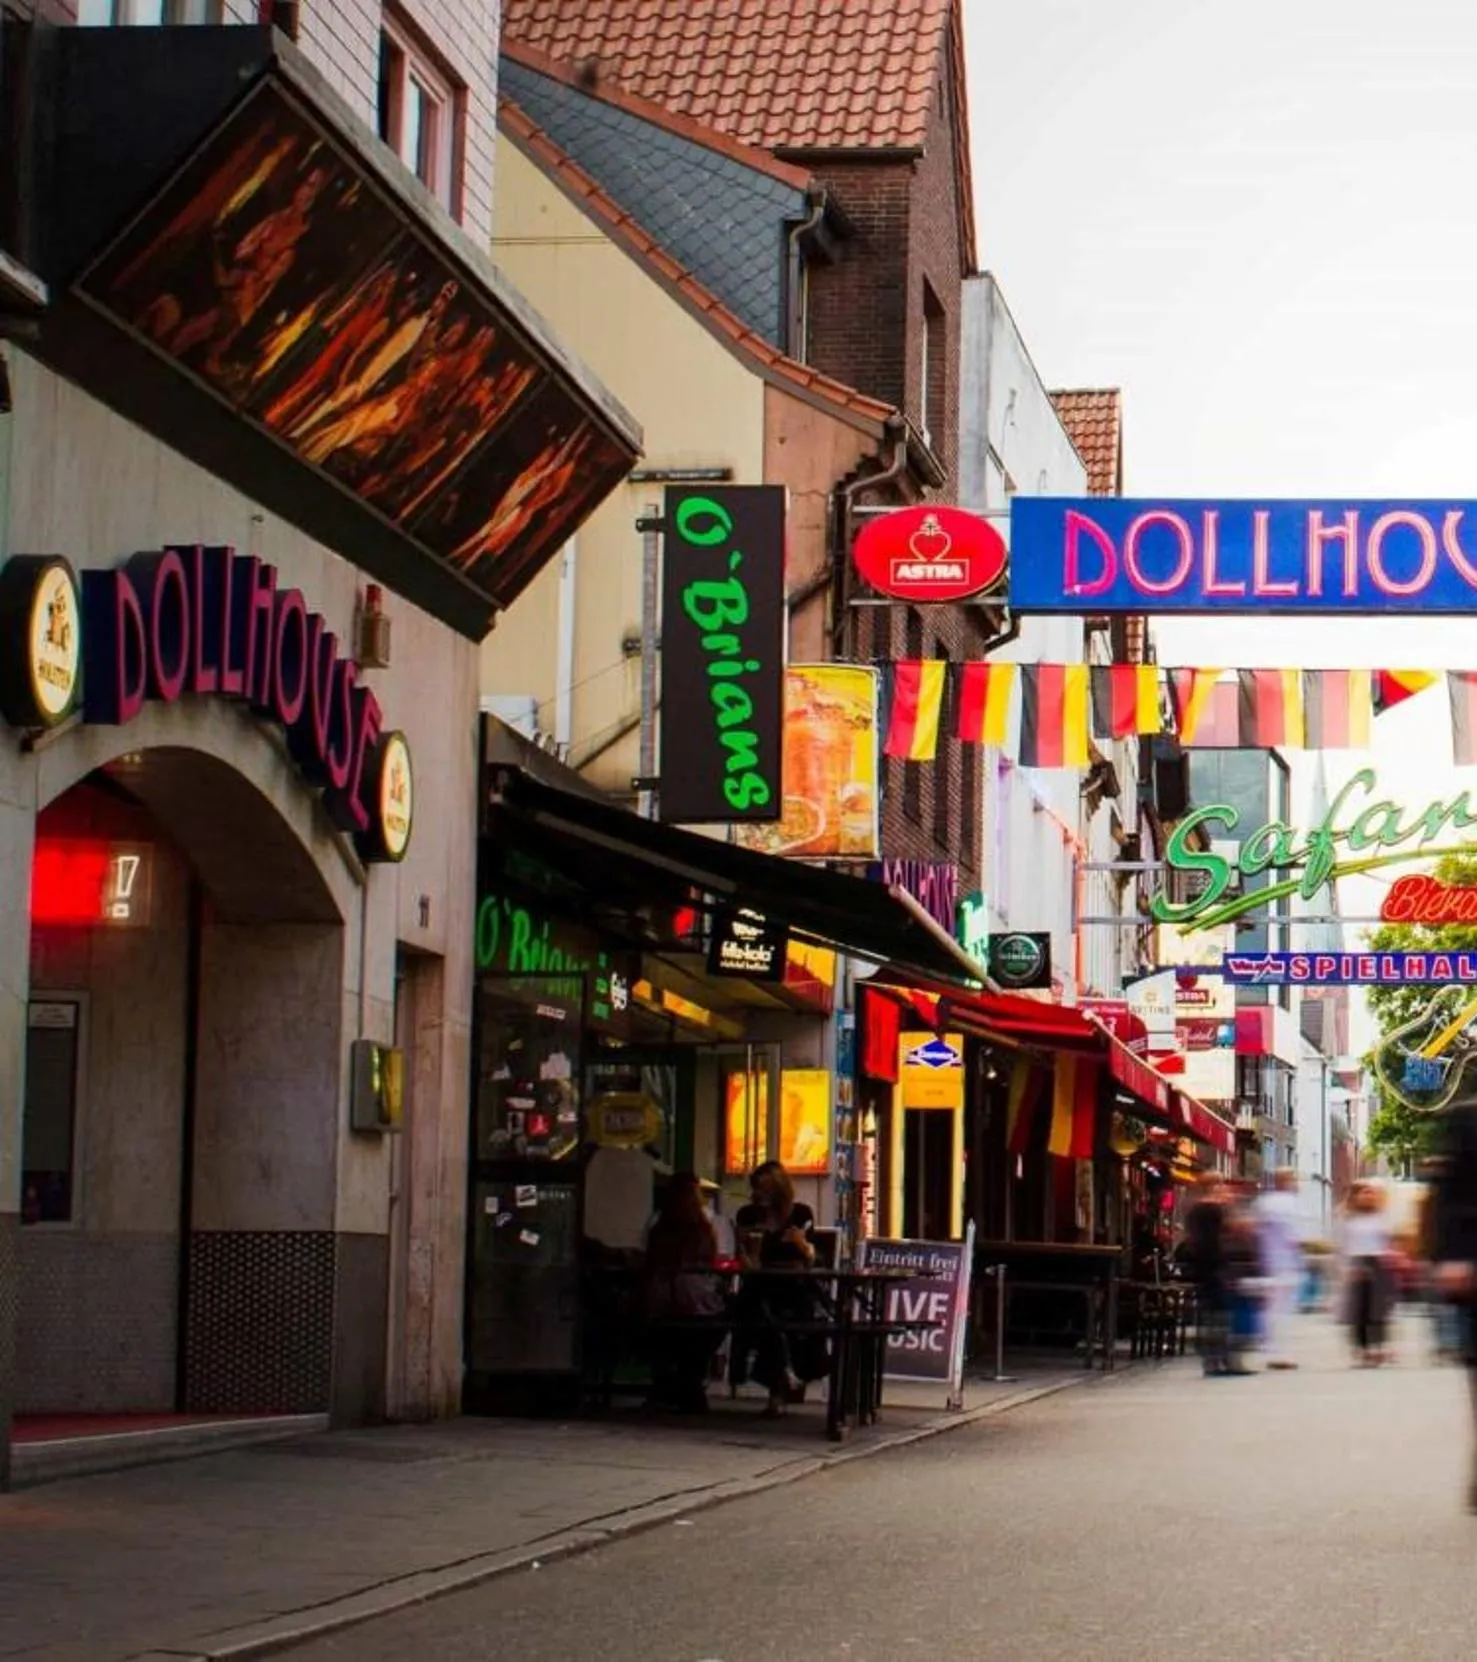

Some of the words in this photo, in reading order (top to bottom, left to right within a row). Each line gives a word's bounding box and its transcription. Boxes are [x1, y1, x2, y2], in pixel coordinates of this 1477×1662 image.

[896, 563, 964, 580] ASTRA
[112, 547, 384, 831] DOLLHOUSE
[889, 1288, 949, 1326] IVE
[887, 1327, 945, 1351] USIC
